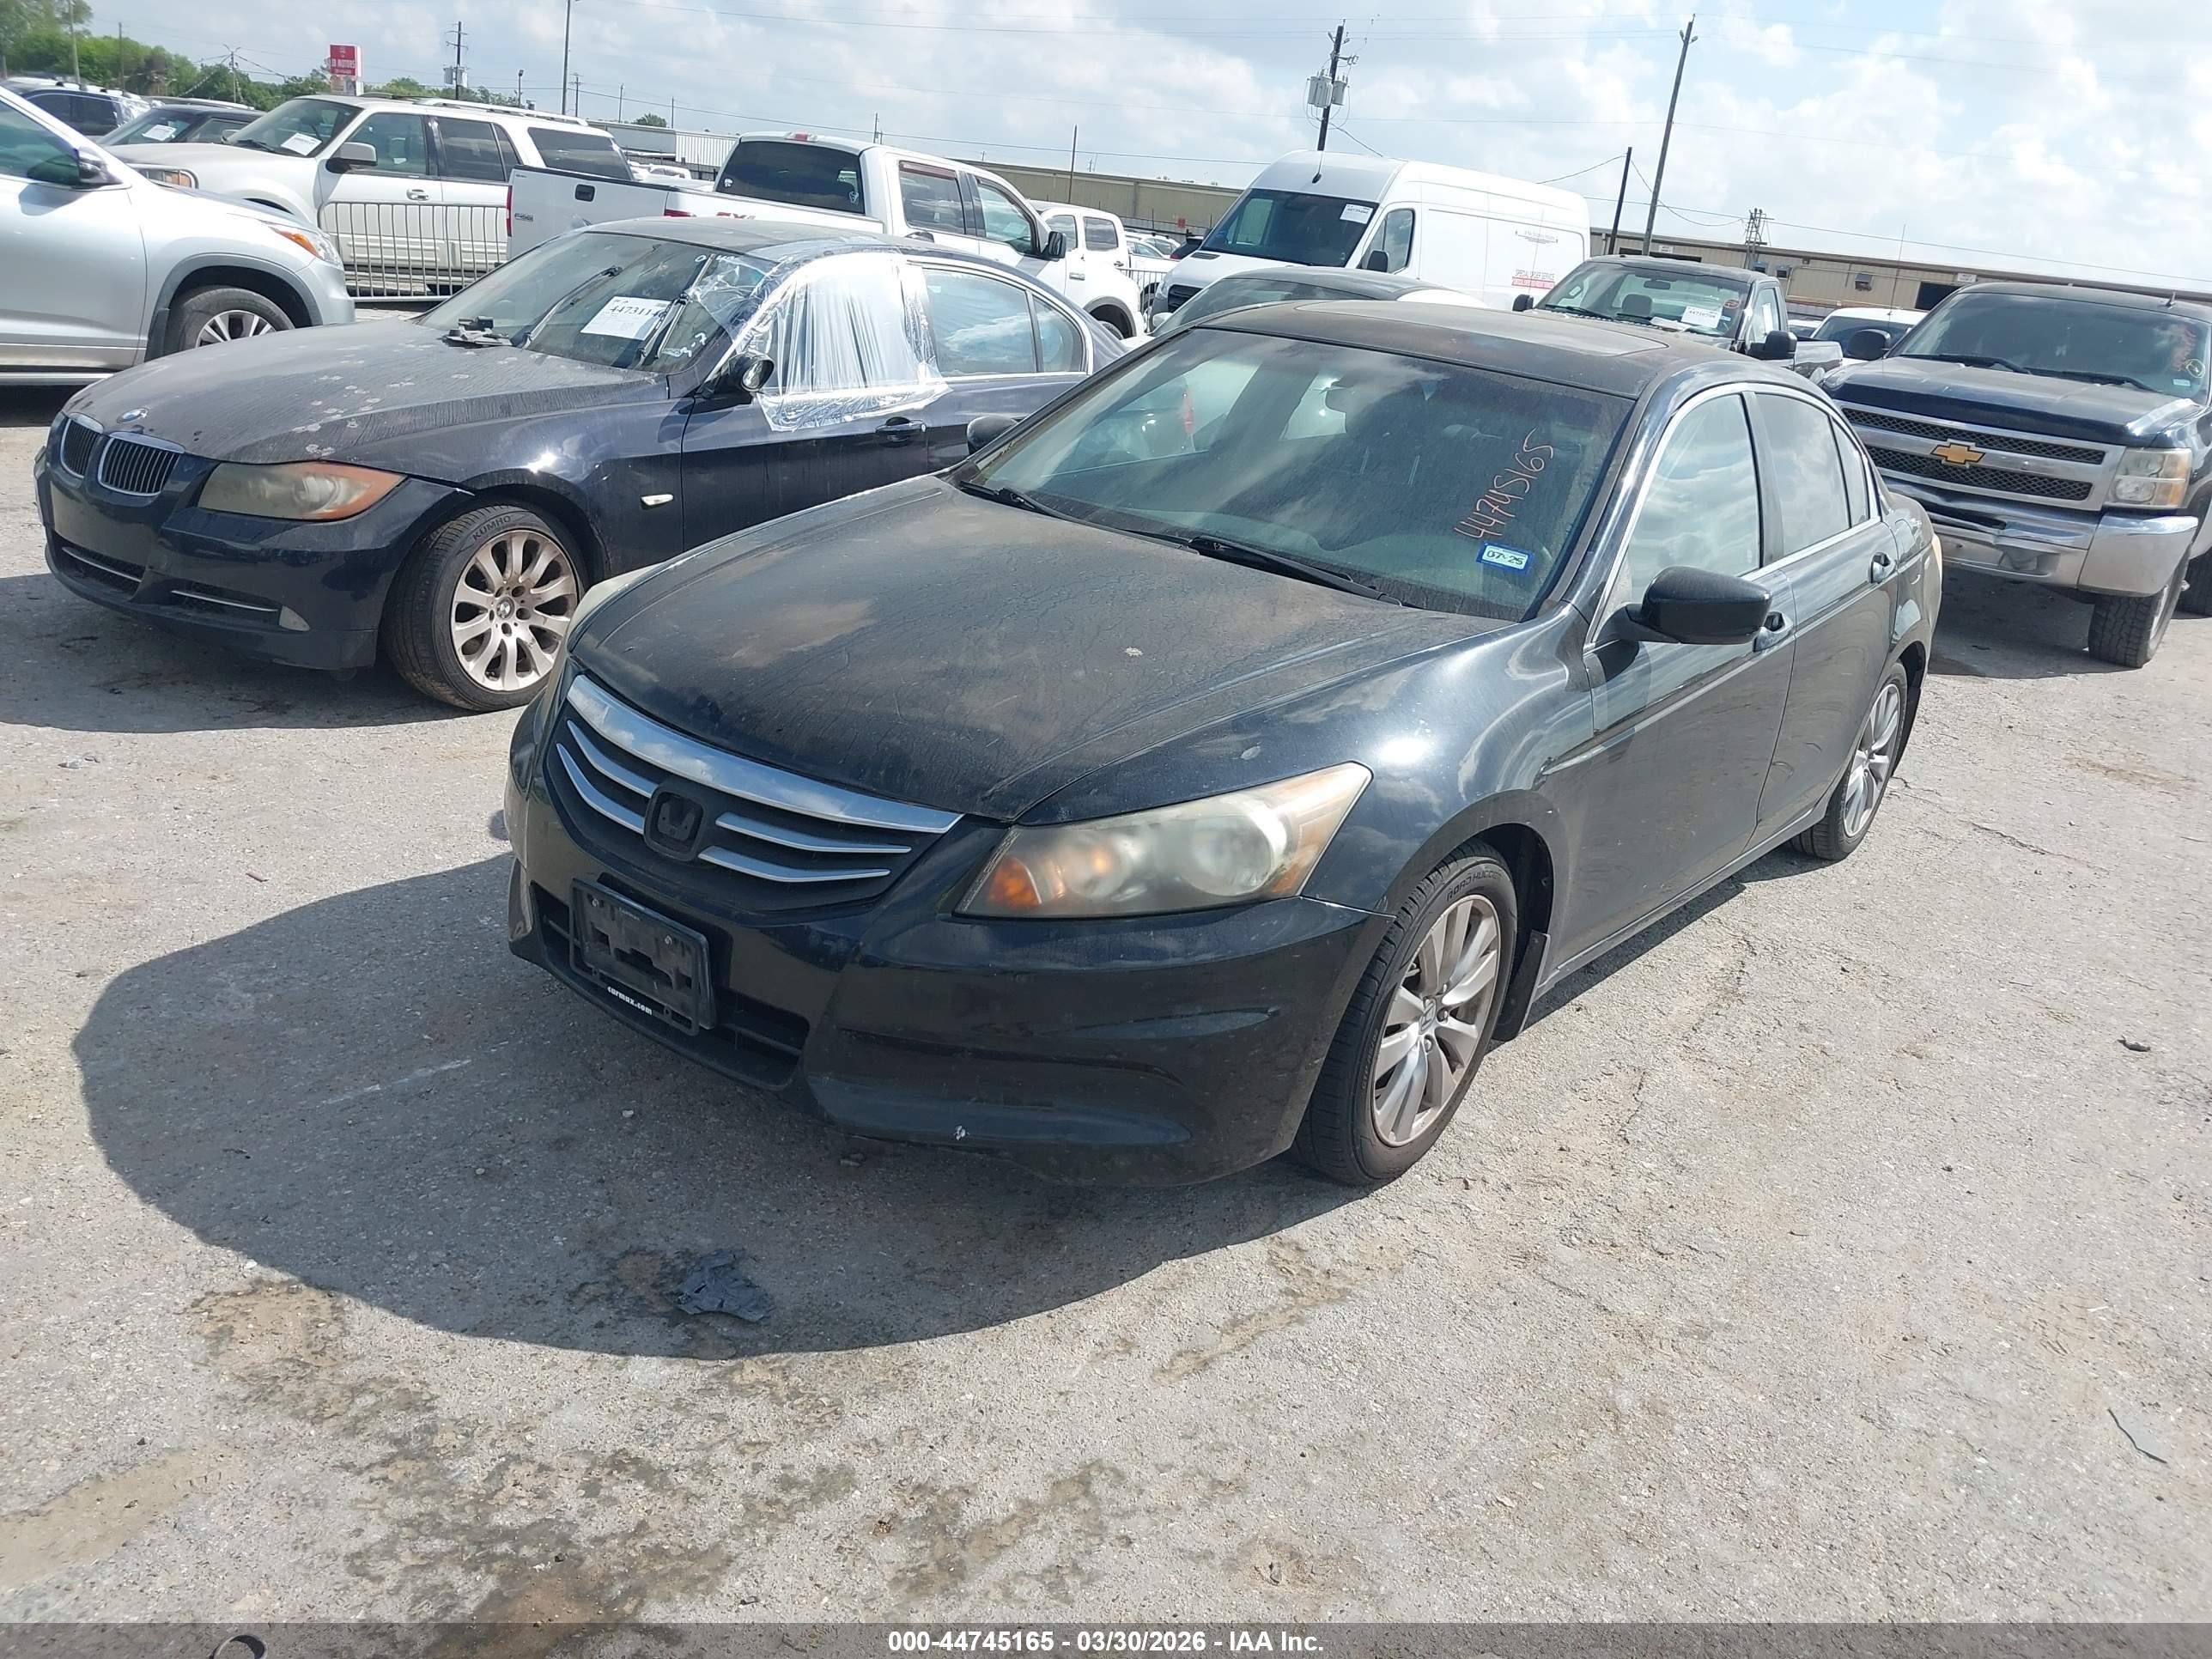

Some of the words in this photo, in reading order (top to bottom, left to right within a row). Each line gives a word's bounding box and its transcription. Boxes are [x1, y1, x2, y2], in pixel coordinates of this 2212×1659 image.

[1454, 426, 1553, 538] 44745165
[472, 515, 512, 541] KUMHO
[607, 986, 653, 1016] carmax.com
